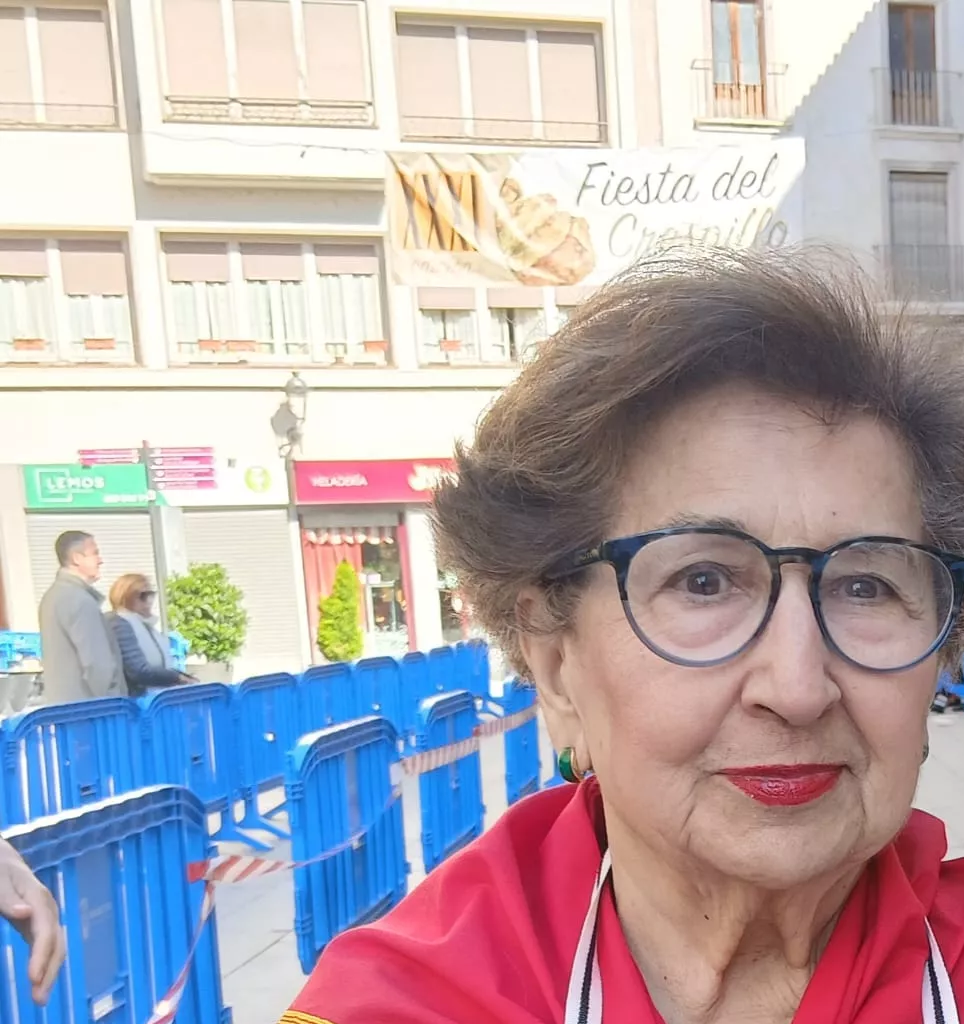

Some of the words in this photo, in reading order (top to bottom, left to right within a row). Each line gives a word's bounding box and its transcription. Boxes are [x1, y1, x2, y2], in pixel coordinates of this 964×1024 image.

[576, 162, 699, 206] Fiesta
[711, 152, 778, 201] del
[46, 476, 105, 490] LEMOS
